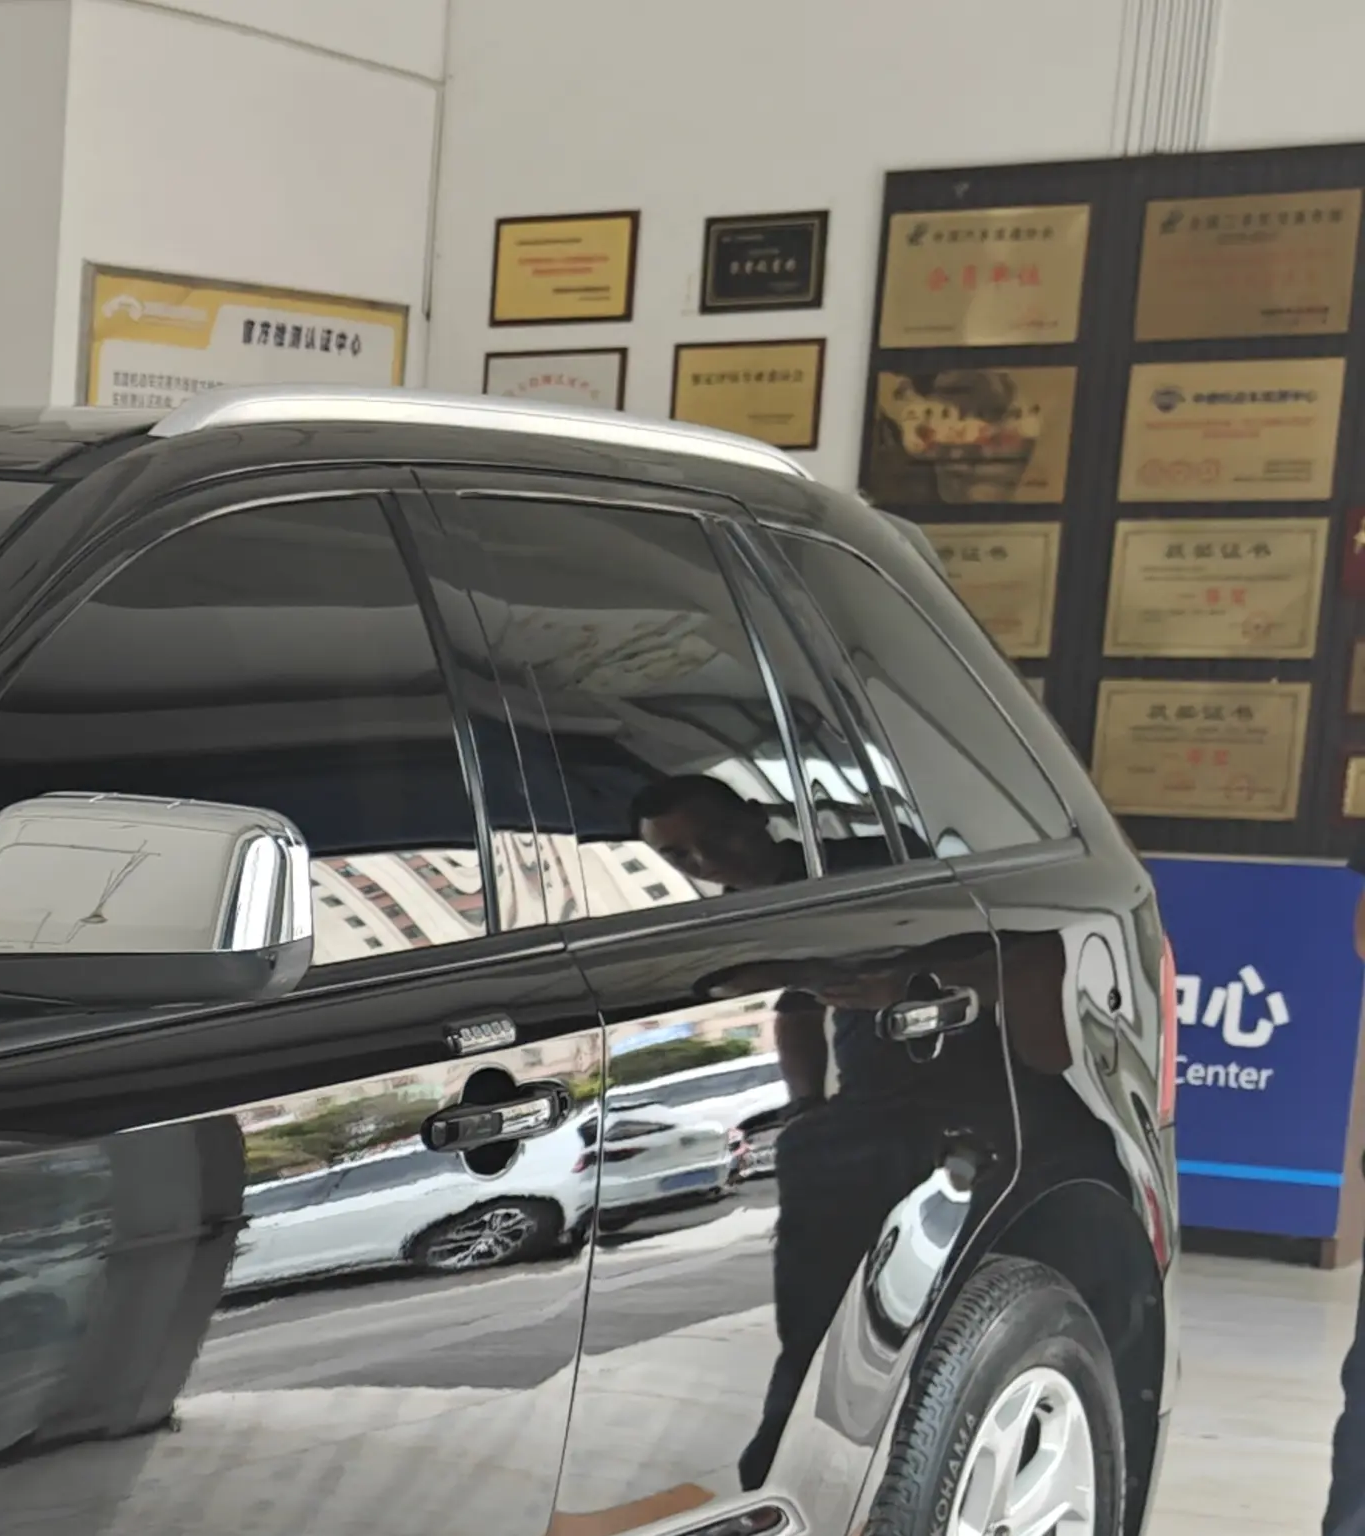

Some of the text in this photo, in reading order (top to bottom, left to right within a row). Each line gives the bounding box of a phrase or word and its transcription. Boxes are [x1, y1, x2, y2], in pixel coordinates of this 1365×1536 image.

[242, 319, 362, 357] 官方检测认证中心
[1173, 1055, 1274, 1091] Center
